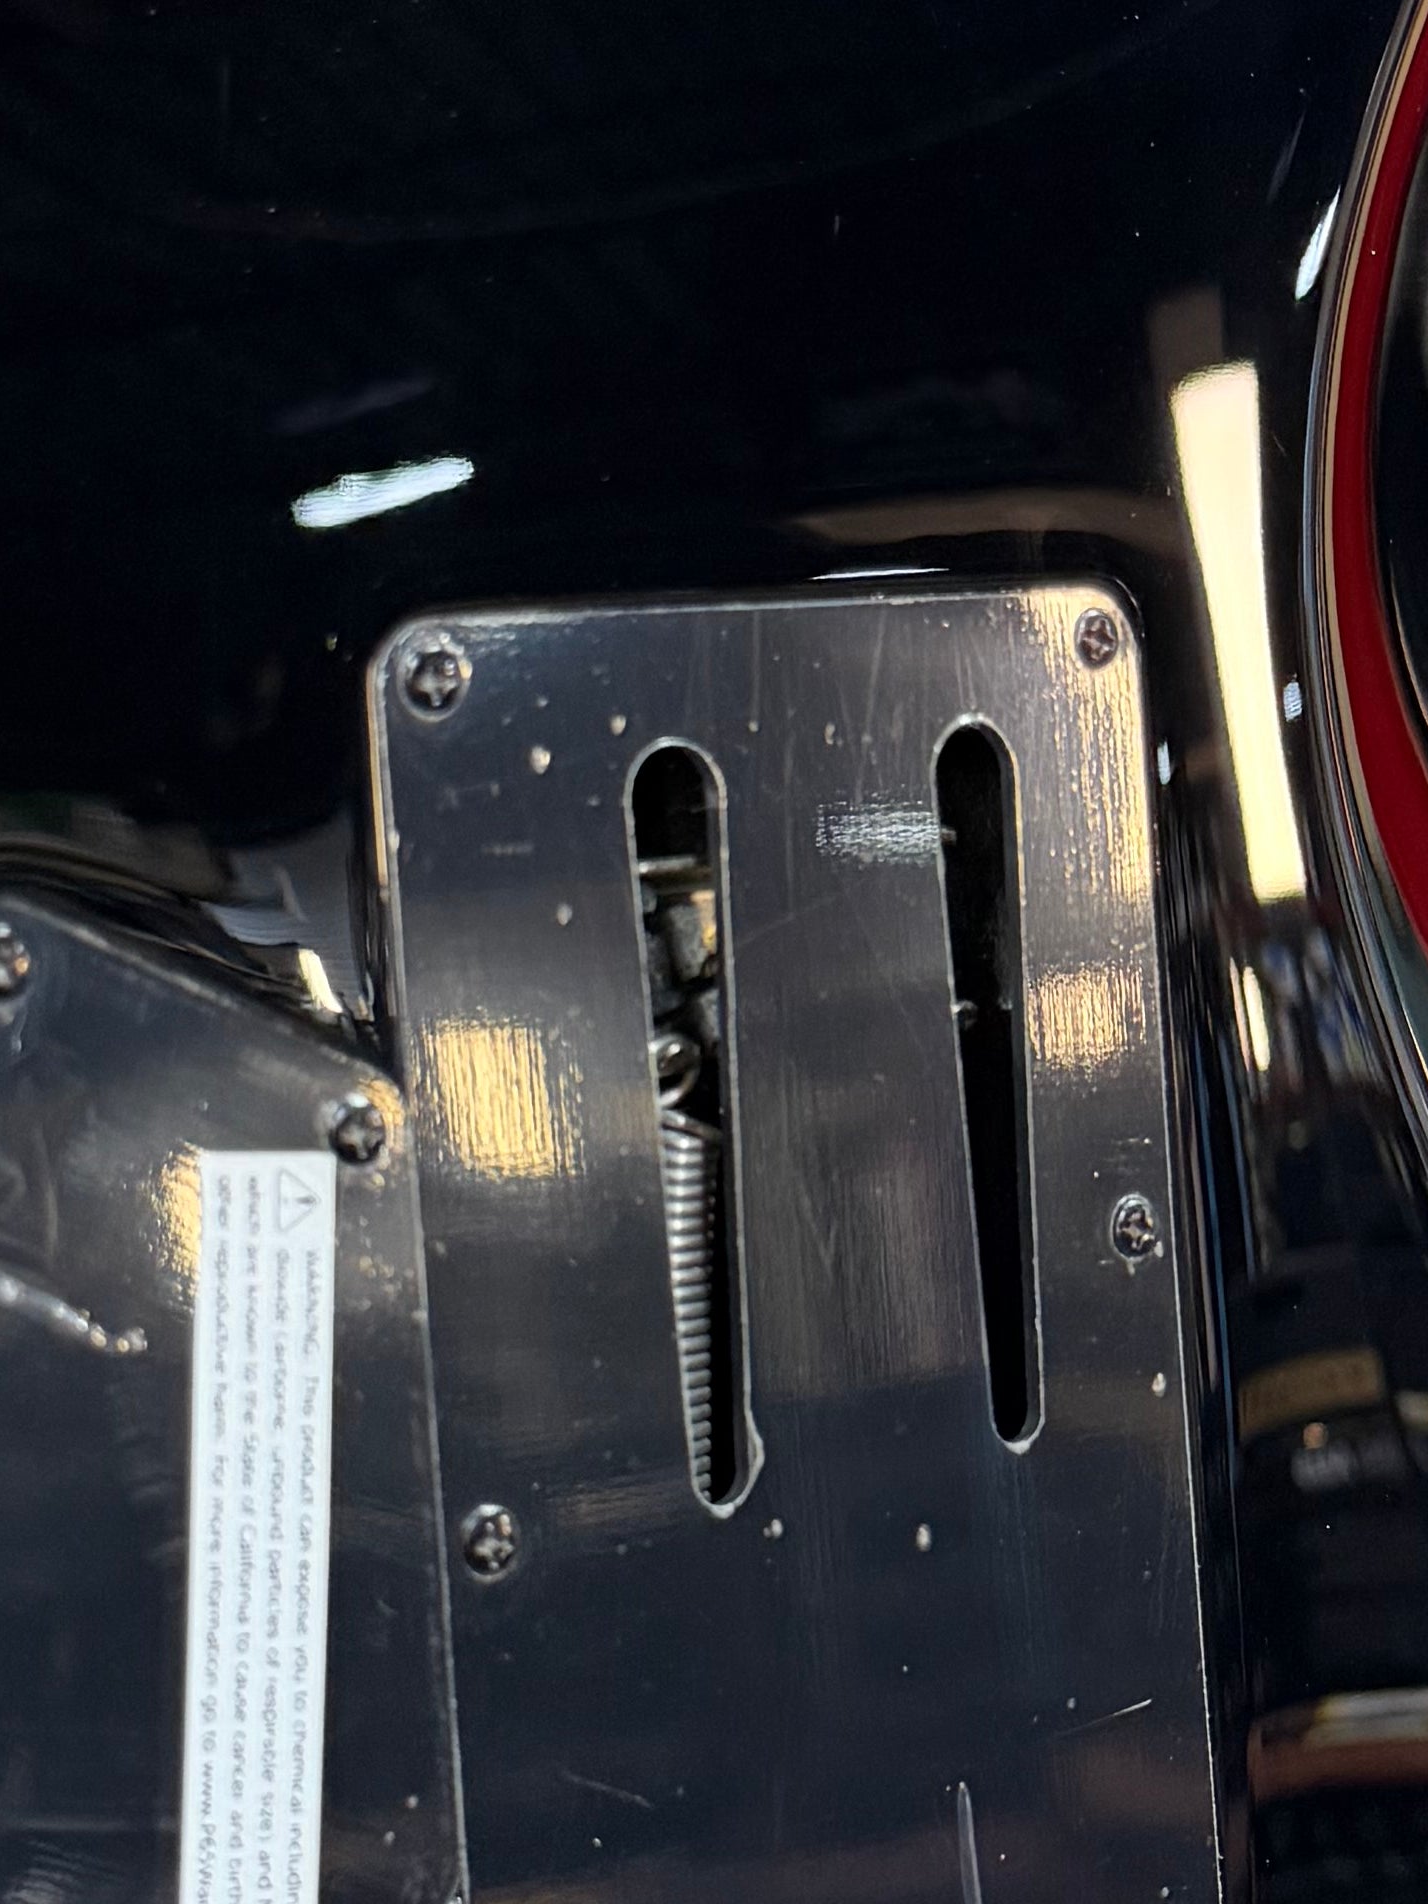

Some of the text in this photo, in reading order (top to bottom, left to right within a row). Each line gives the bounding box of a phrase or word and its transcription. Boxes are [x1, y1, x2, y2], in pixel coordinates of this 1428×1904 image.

[240, 1431, 259, 1489] State
[209, 1496, 227, 1554] more
[241, 1495, 257, 1517] of
[298, 1515, 314, 1555] can
[236, 1523, 258, 1626] California
[265, 1549, 285, 1640] particles
[294, 1558, 311, 1637] expose
[204, 1560, 226, 1687] information
[235, 1630, 251, 1654] to
[266, 1646, 281, 1670] of
[292, 1645, 309, 1682] you
[199, 1694, 219, 1724] go
[233, 1659, 249, 1724] cause
[292, 1690, 308, 1715] to
[200, 1729, 217, 1753] to
[230, 1729, 246, 1800] cancer
[288, 1719, 308, 1815] chemical
[228, 1809, 246, 1850] and
[258, 1849, 275, 1891] and
